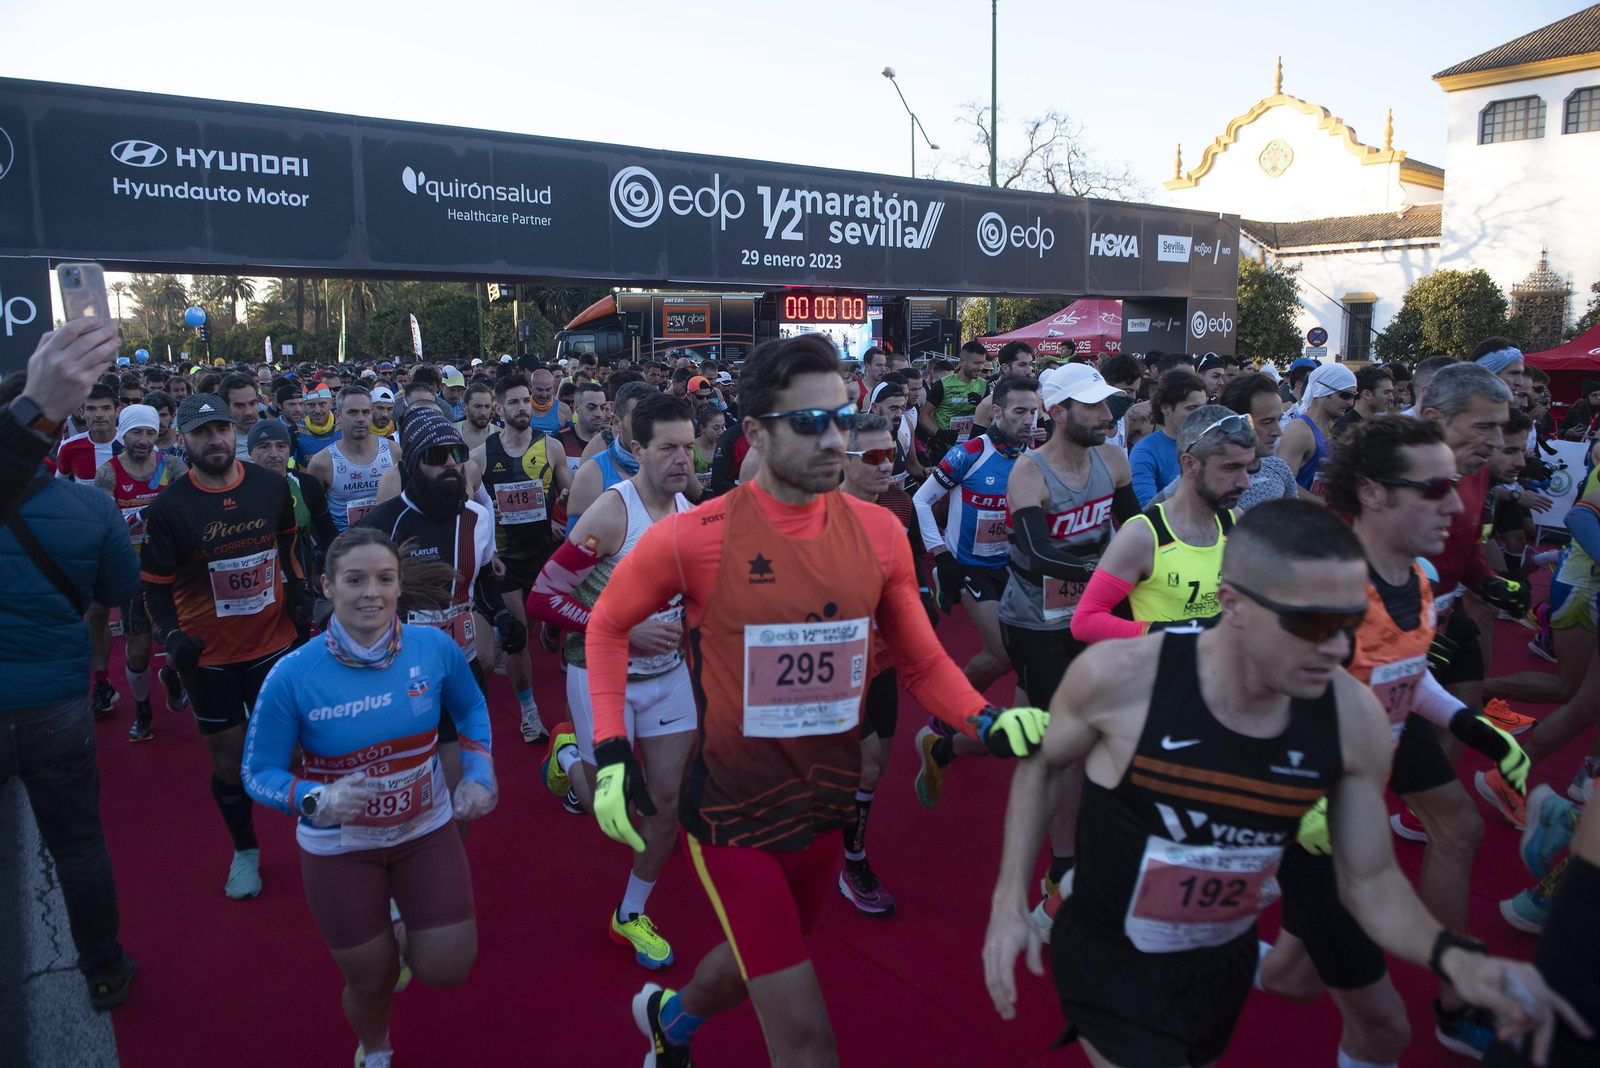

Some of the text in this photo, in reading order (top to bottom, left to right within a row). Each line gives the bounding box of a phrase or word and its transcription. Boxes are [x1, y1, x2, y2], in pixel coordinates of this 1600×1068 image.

[176, 147, 309, 177] HYUNDAI
[112, 177, 309, 207] Hyundauto Motor
[425, 178, 552, 204] quirónsalud
[669, 173, 745, 231] edp
[795, 189, 918, 223] maratón
[447, 208, 552, 226] Healthcare Partner
[828, 213, 920, 249] sevilla
[1010, 216, 1055, 259] edp
[1089, 232, 1140, 258] HOKA
[741, 249, 842, 269] 29 enero 2023
[785, 296, 864, 320] 00 00 00
[1208, 311, 1233, 338] edp
[343, 480, 379, 491] MARACE
[506, 491, 529, 505] 418
[202, 518, 267, 542] Picoco
[410, 547, 439, 557] PLAYLIFE
[229, 569, 259, 590] 662
[1187, 581, 1200, 603] 7
[776, 629, 799, 646] edp
[776, 651, 835, 687] 295
[308, 692, 392, 721] enerplus
[366, 790, 411, 817] 893
[1179, 875, 1248, 908] 192
